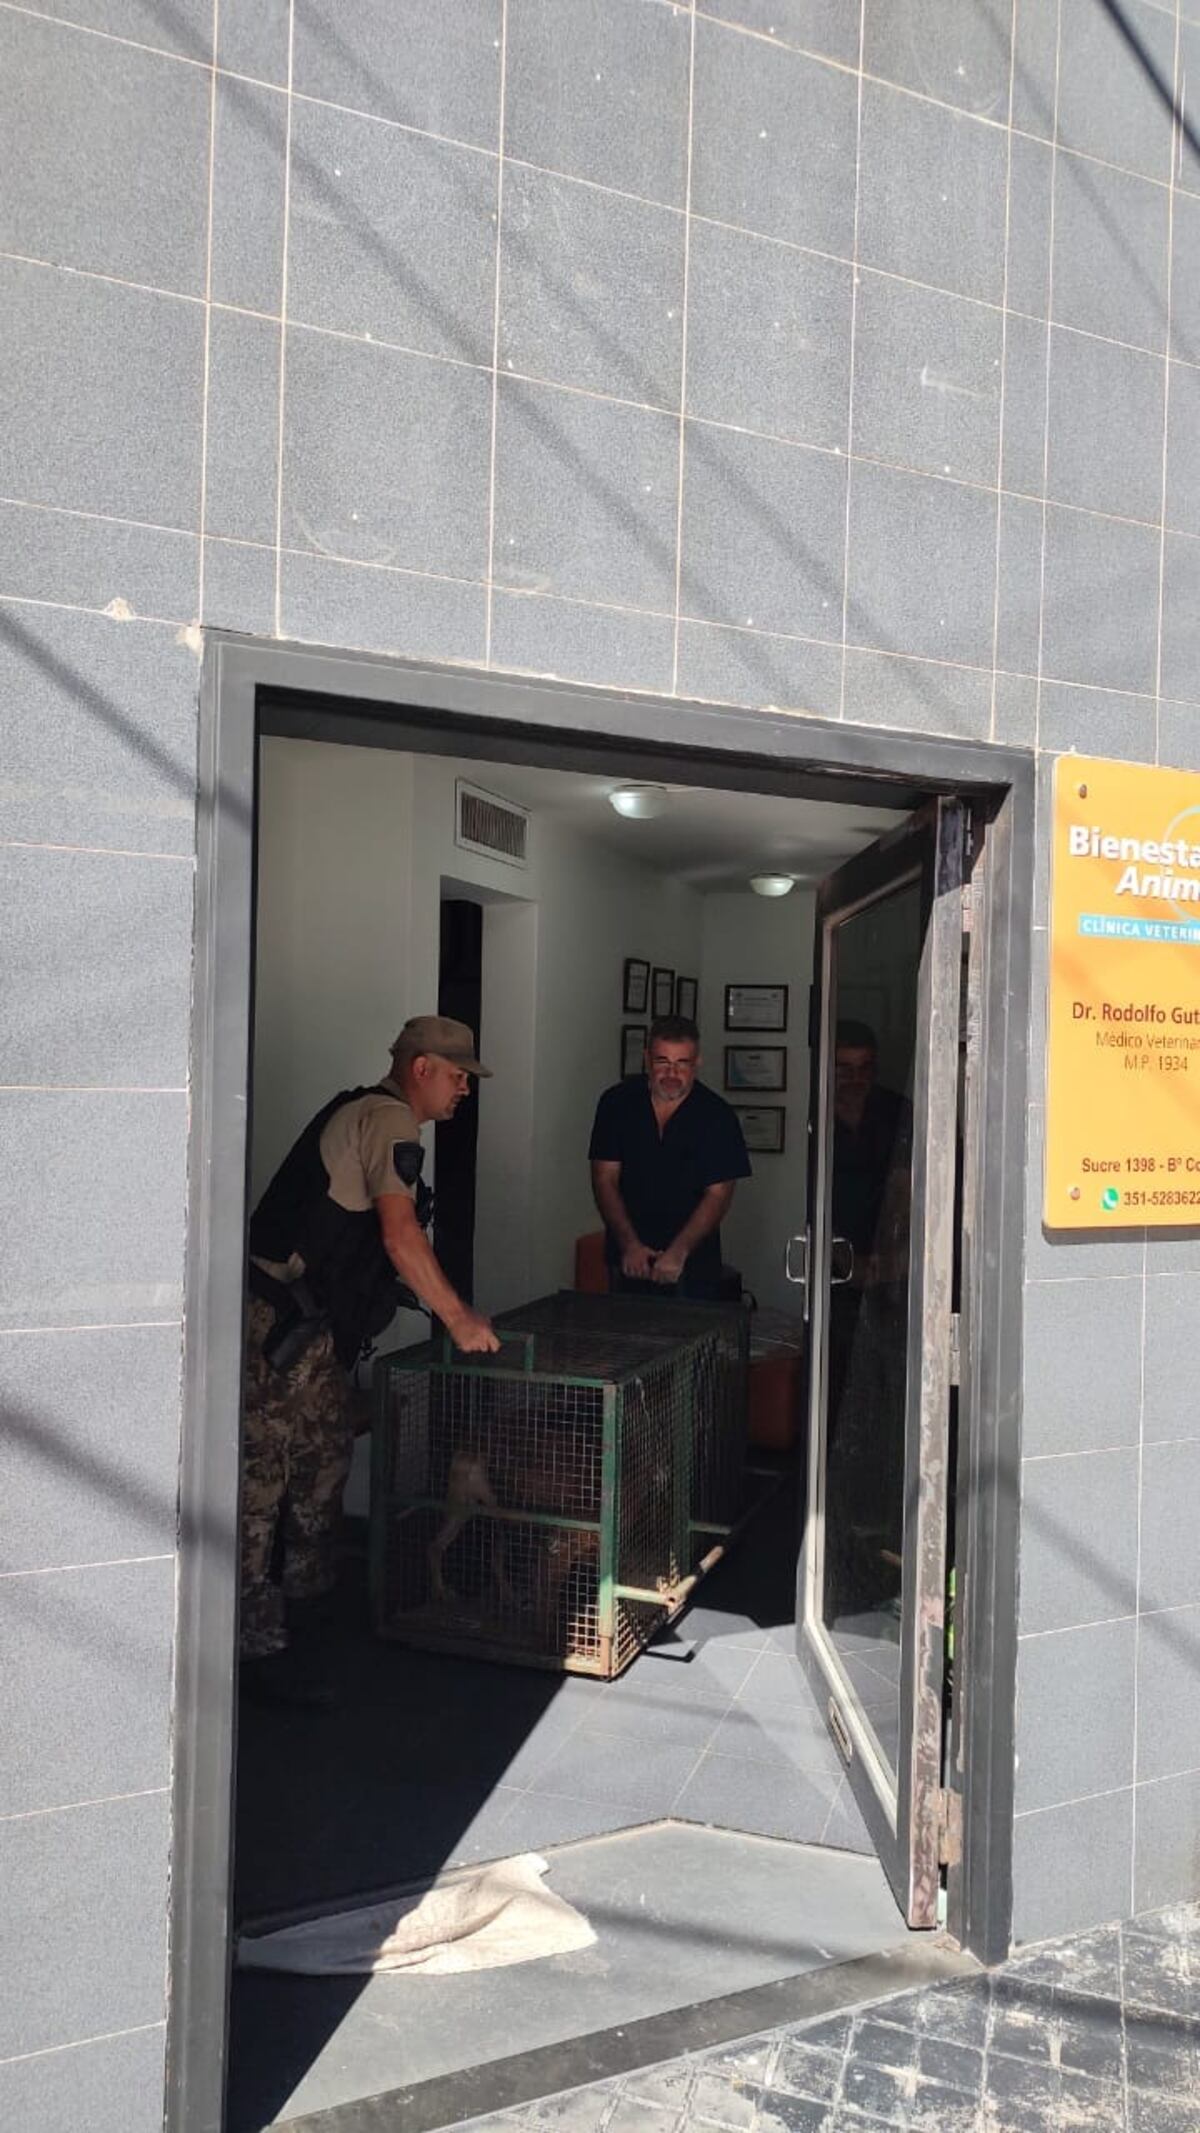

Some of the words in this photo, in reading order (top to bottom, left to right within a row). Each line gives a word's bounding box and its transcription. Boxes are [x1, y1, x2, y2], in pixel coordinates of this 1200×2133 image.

[1070, 825, 1200, 868] Bienesta
[1083, 918, 1140, 937] CLÍNICA
[1072, 1002, 1096, 1020] Dr.
[1103, 1003, 1166, 1023] Rodolfo
[1097, 1032, 1143, 1049] Médico
[1159, 1055, 1188, 1071] 1934
[1082, 1158, 1121, 1172] Sucre
[1126, 1157, 1156, 1172] 1398
